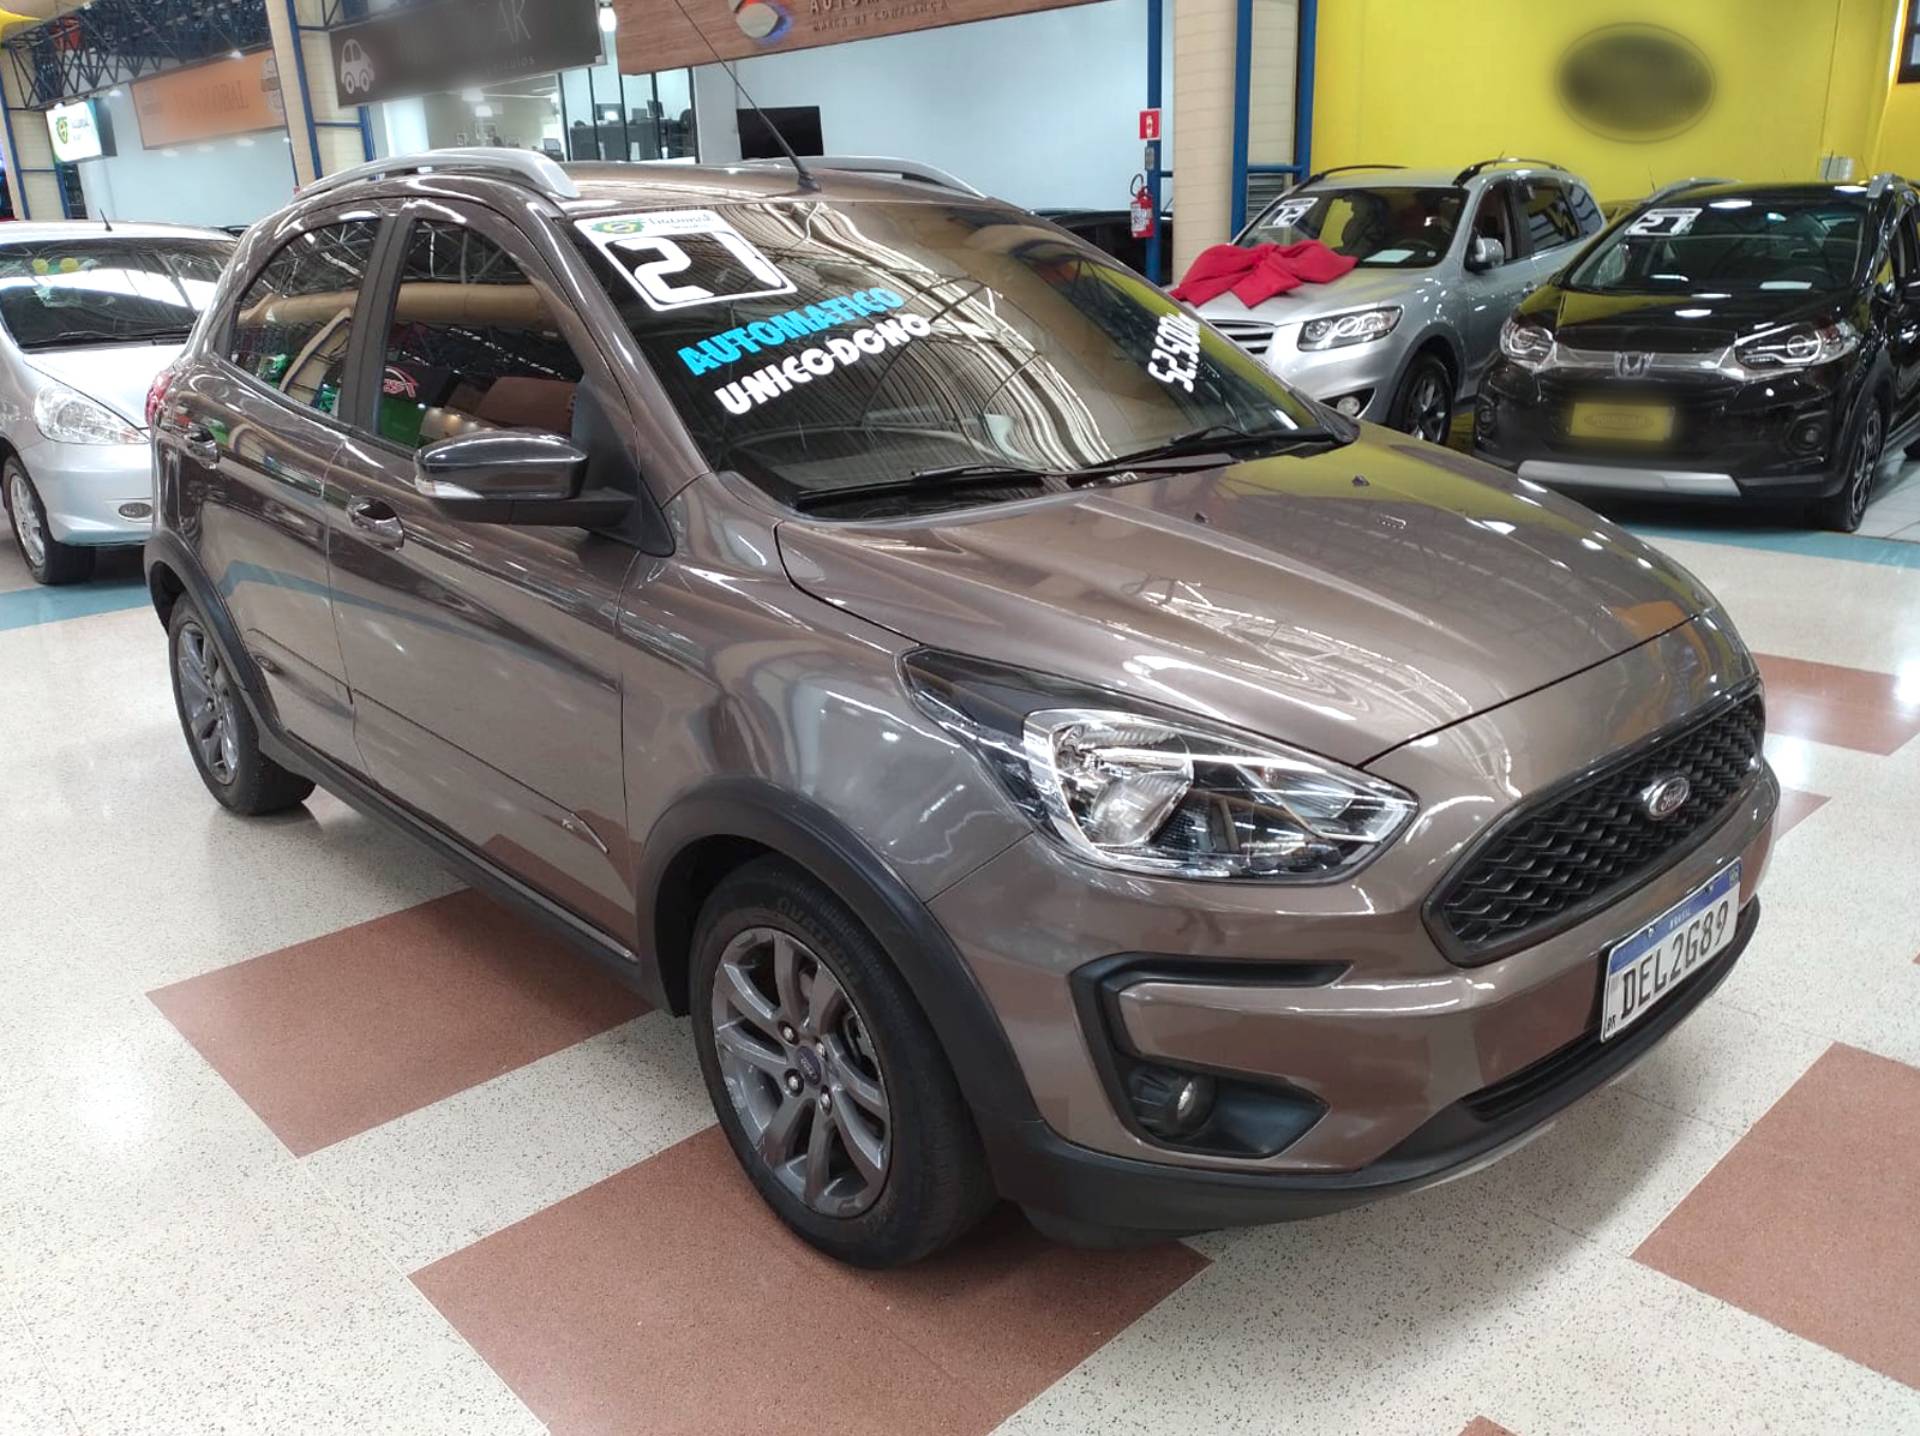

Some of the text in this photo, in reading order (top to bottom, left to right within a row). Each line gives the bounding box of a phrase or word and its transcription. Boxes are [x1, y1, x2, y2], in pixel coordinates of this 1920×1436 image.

[613, 231, 783, 303] 21
[678, 287, 905, 376] AUTOMATICO
[714, 313, 931, 415] UNICO DONO
[1621, 901, 1729, 1020] DEL2G89
